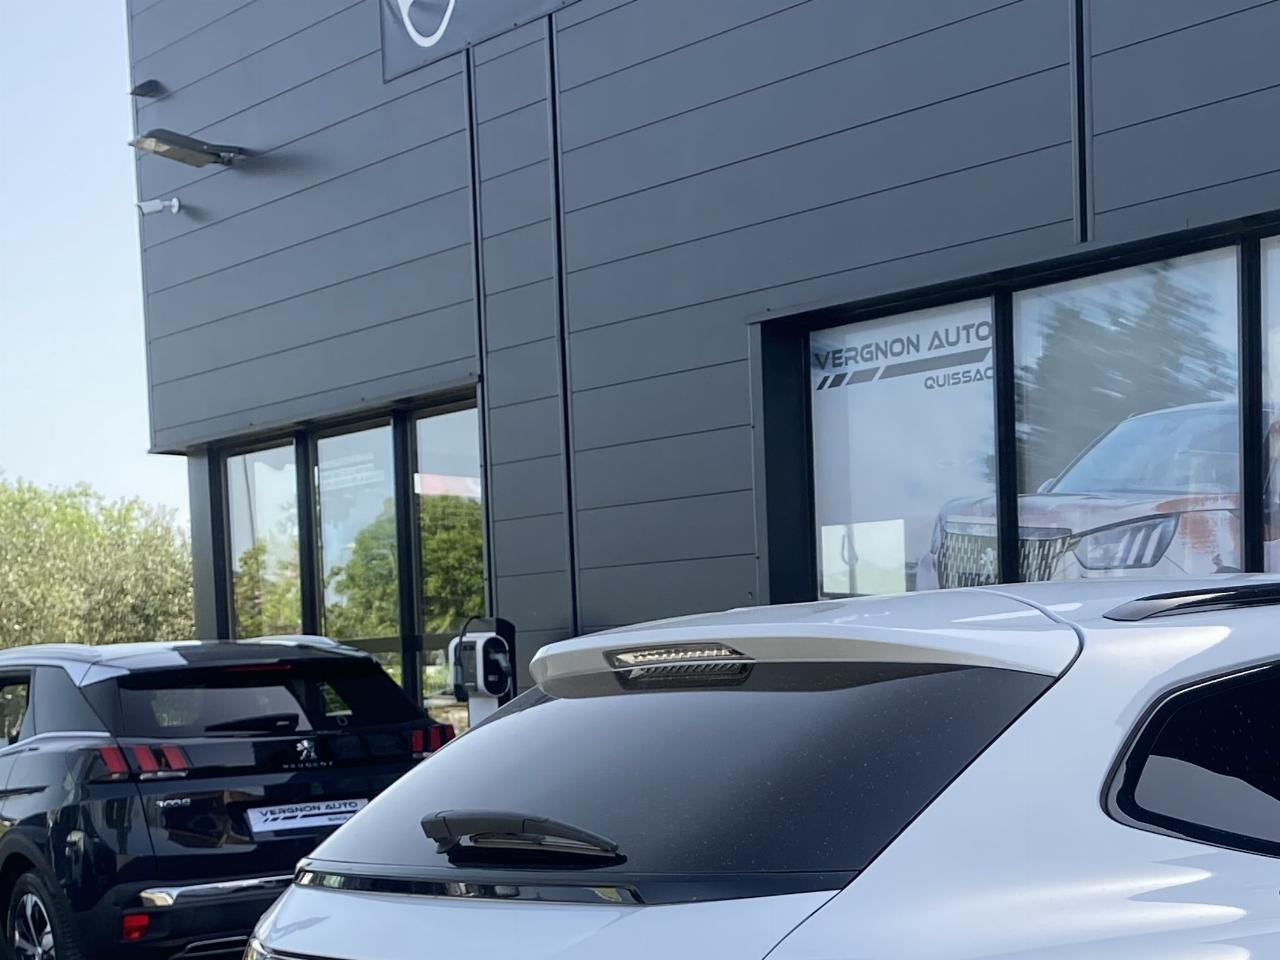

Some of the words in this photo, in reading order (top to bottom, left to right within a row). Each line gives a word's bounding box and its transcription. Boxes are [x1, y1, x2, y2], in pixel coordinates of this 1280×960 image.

[814, 333, 921, 371] VERGNON
[927, 320, 993, 351] AUTO
[924, 366, 994, 389] QUISSAC
[325, 801, 358, 811] AUTO
